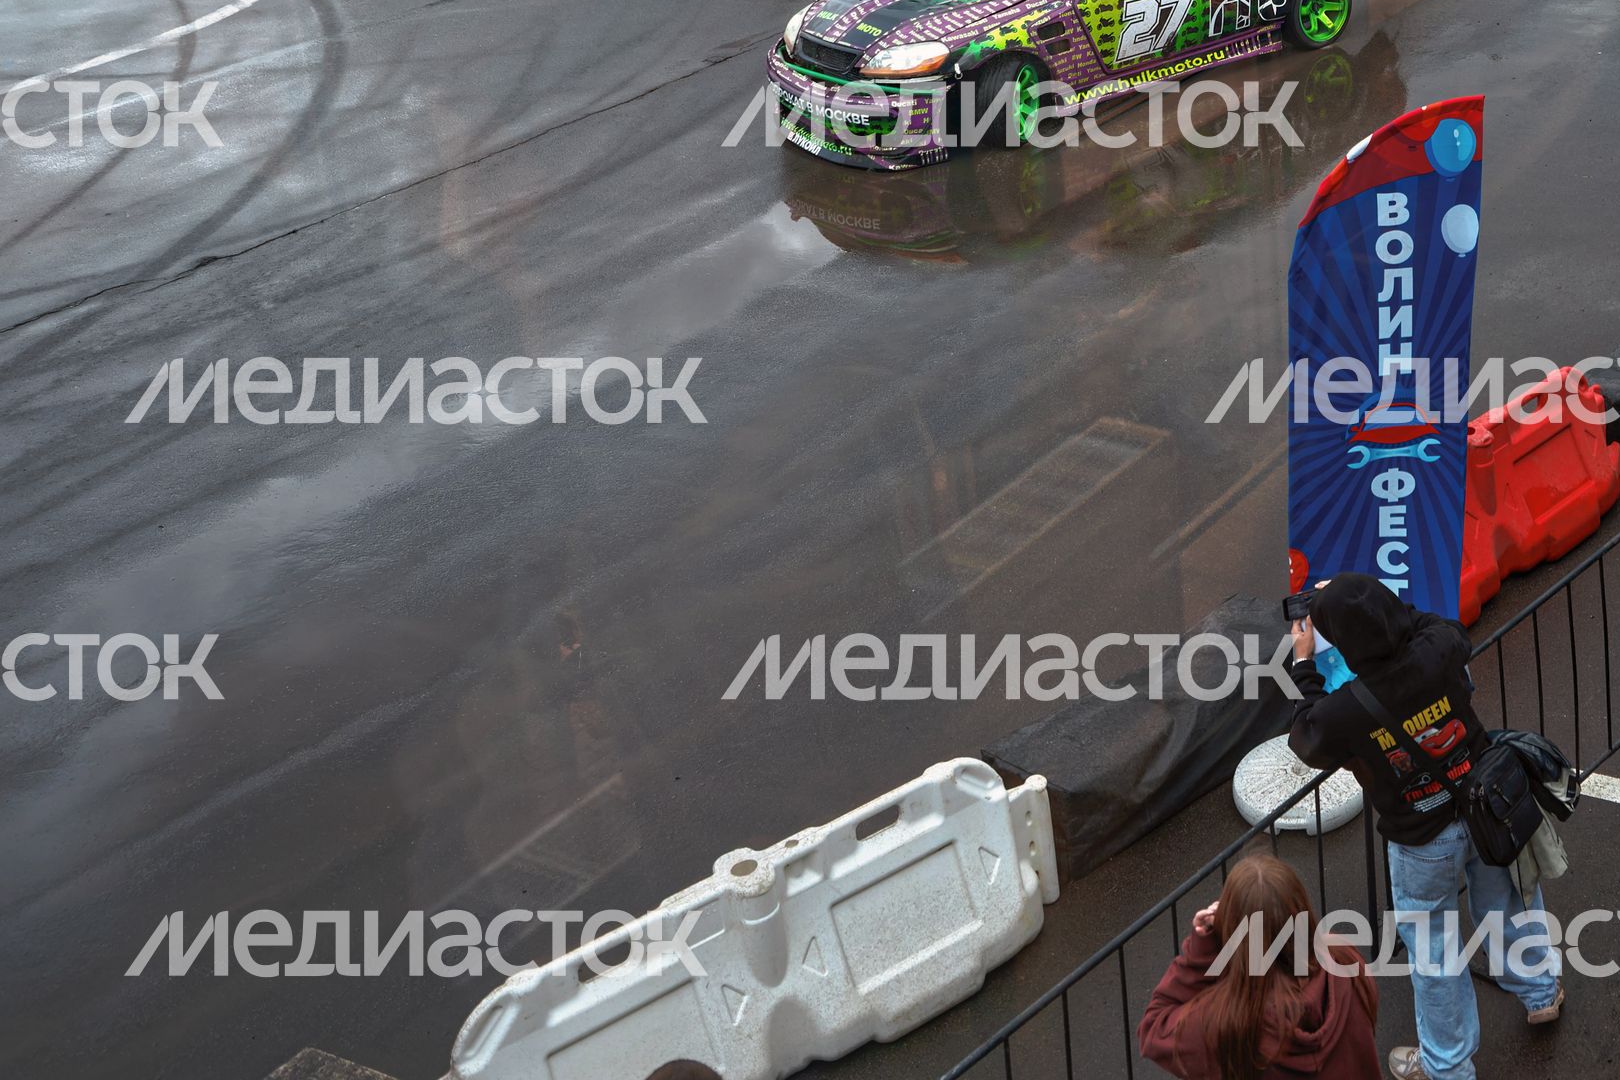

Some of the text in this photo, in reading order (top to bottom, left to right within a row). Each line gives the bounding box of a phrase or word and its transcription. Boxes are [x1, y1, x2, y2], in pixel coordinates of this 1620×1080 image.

[817, 10, 838, 21] HULK
[856, 22, 883, 38] MOTO
[941, 29, 979, 44] Kawasaki
[1065, 49, 1226, 105] www.hulkmoto.ru
[806, 102, 813, 113] В
[815, 105, 870, 126] МОСКВЕ
[891, 100, 917, 108] Ducati
[794, 132, 822, 156] ЛУКОЙЛ
[1374, 192, 1414, 377] ВОЛИН
[1371, 468, 1416, 597] ФЕСТ
